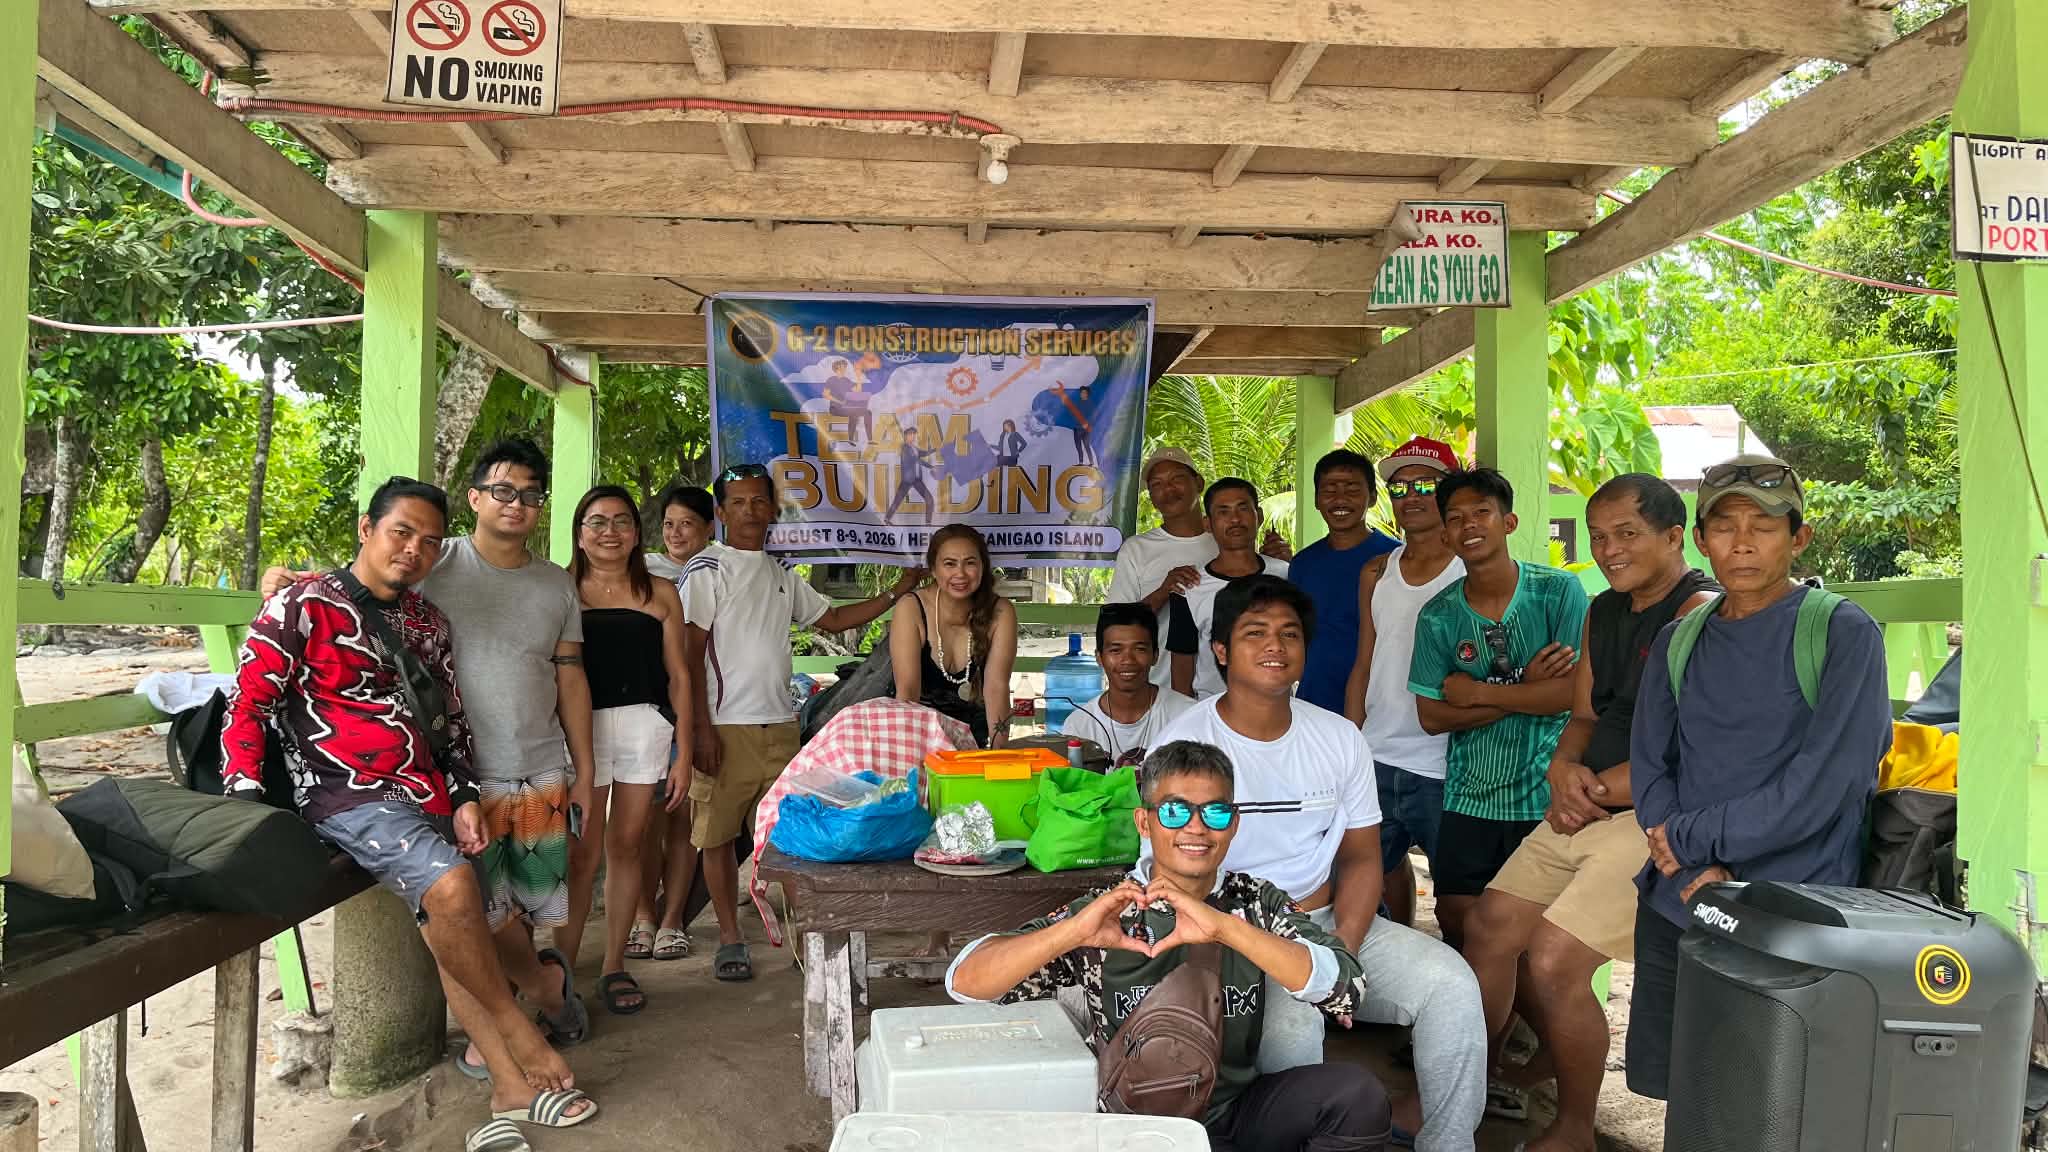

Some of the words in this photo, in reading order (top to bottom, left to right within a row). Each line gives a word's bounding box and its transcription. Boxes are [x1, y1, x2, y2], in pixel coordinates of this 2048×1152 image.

[404, 55, 470, 101] NO
[475, 60, 543, 82] SMOKING
[476, 82, 542, 107] VAPING
[1969, 142, 2024, 159] LIGPIT
[2036, 148, 2048, 160] A
[1461, 210, 1498, 225] KO,
[1981, 205, 1999, 219] AT
[1446, 234, 1482, 248] KO.
[1420, 254, 1440, 304] AS
[1443, 254, 1474, 303] YOU
[1478, 254, 1500, 303] GO
[787, 324, 828, 353] G-2
[834, 325, 1021, 355] CONSTRUCTION
[1025, 328, 1137, 356] SERVICES
[770, 411, 971, 463] TEAM
[772, 460, 1106, 514] BUILDING
[765, 529, 832, 545] AUGUST
[837, 529, 862, 545] 8-9,
[864, 531, 896, 546] 2026
[908, 531, 934, 547] HE
[982, 531, 1043, 547] ANIGAO
[1049, 532, 1104, 546] ISLAND
[1693, 902, 1739, 933] SWOTCH
